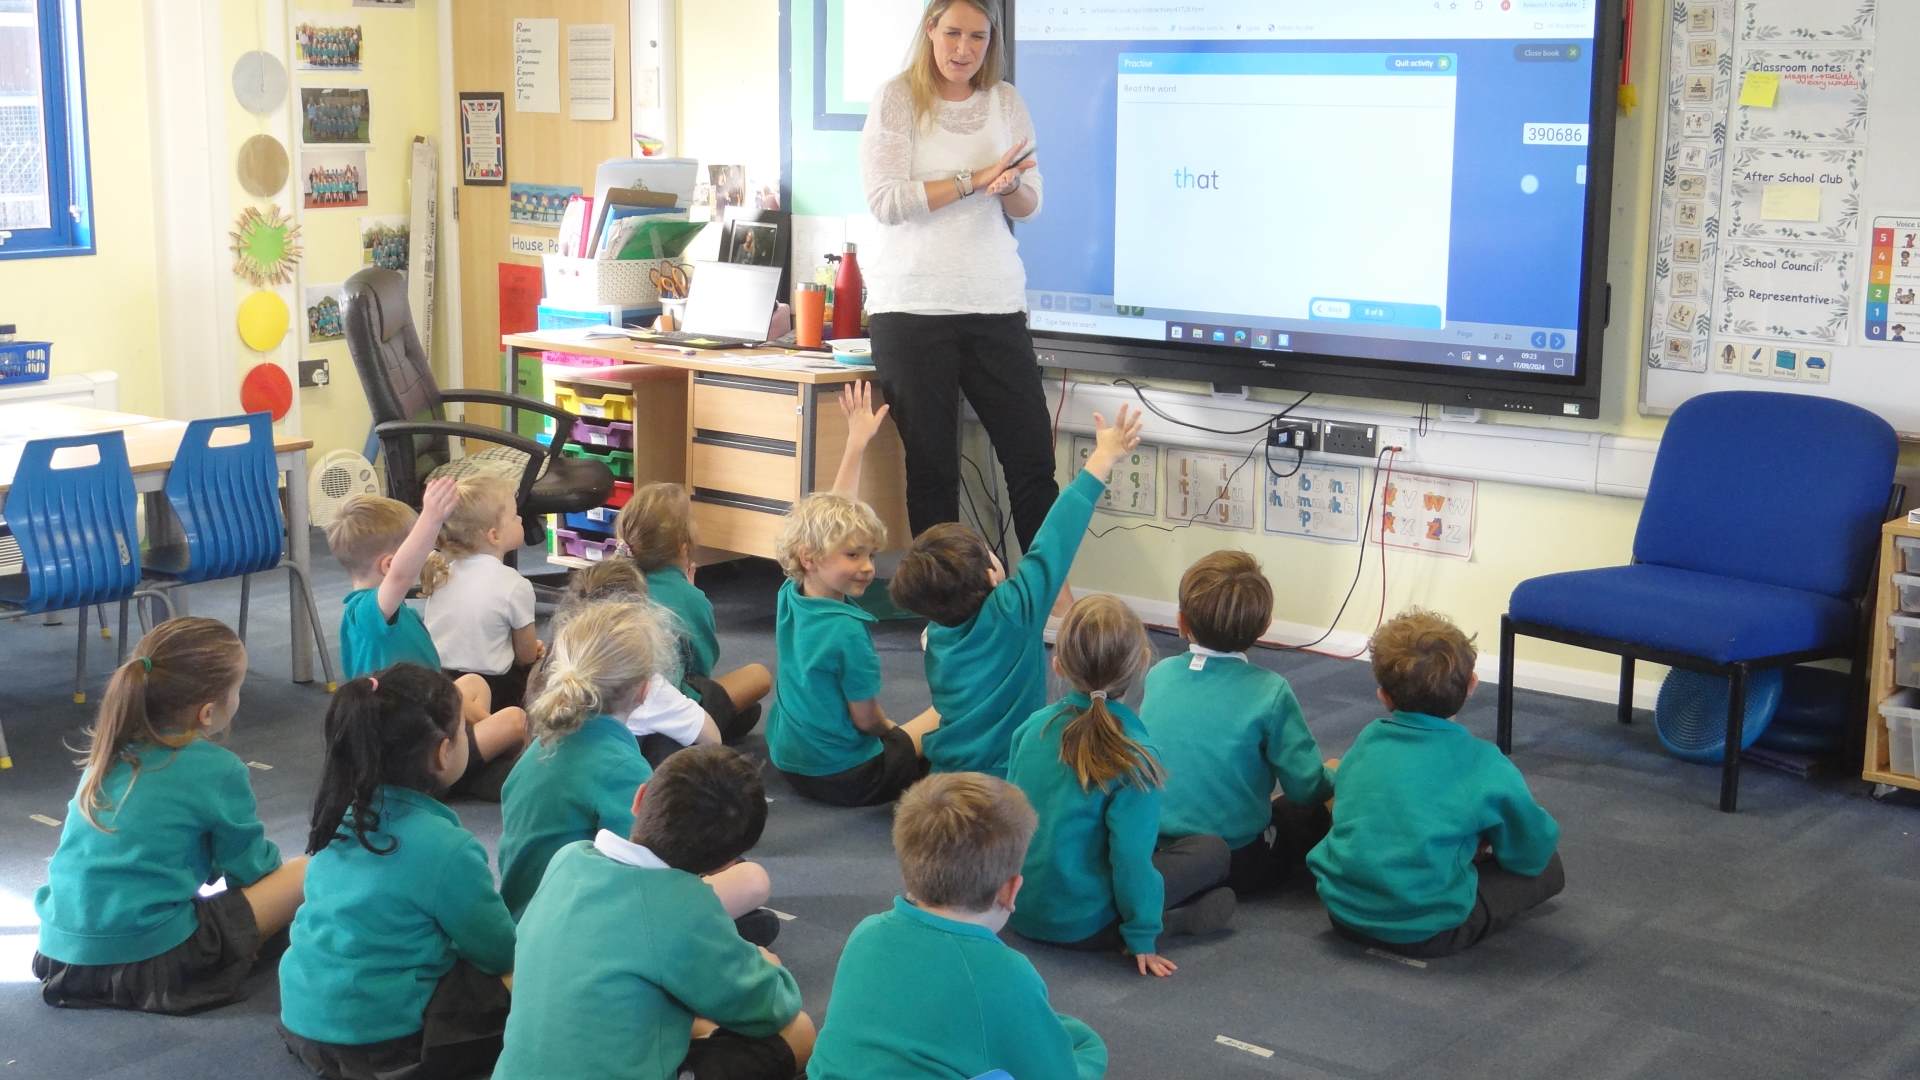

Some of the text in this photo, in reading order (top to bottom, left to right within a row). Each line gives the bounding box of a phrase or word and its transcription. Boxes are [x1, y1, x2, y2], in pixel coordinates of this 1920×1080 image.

[1395, 59, 1433, 69] Quit activity
[1753, 62, 1846, 72] Classroom notes:
[1124, 84, 1177, 93] Read the word
[1528, 128, 1582, 142] 390686
[1174, 166, 1219, 190] that
[1744, 171, 1843, 184] After School Club
[512, 236, 543, 251] House
[1880, 233, 1887, 242] 5
[1878, 252, 1885, 261] 4
[1742, 258, 1823, 272] School Council:
[1877, 270, 1883, 280] 3
[1726, 287, 1835, 305] Eco Representative:
[1875, 289, 1882, 298] 2
[1874, 307, 1879, 317] 1
[1872, 326, 1880, 335] 0
[1131, 454, 1140, 465] o
[1300, 473, 1312, 491] b
[1331, 478, 1344, 494] n
[1271, 490, 1283, 507] h
[1331, 496, 1343, 513] k
[1424, 494, 1445, 512] w
[1300, 509, 1311, 527] p
